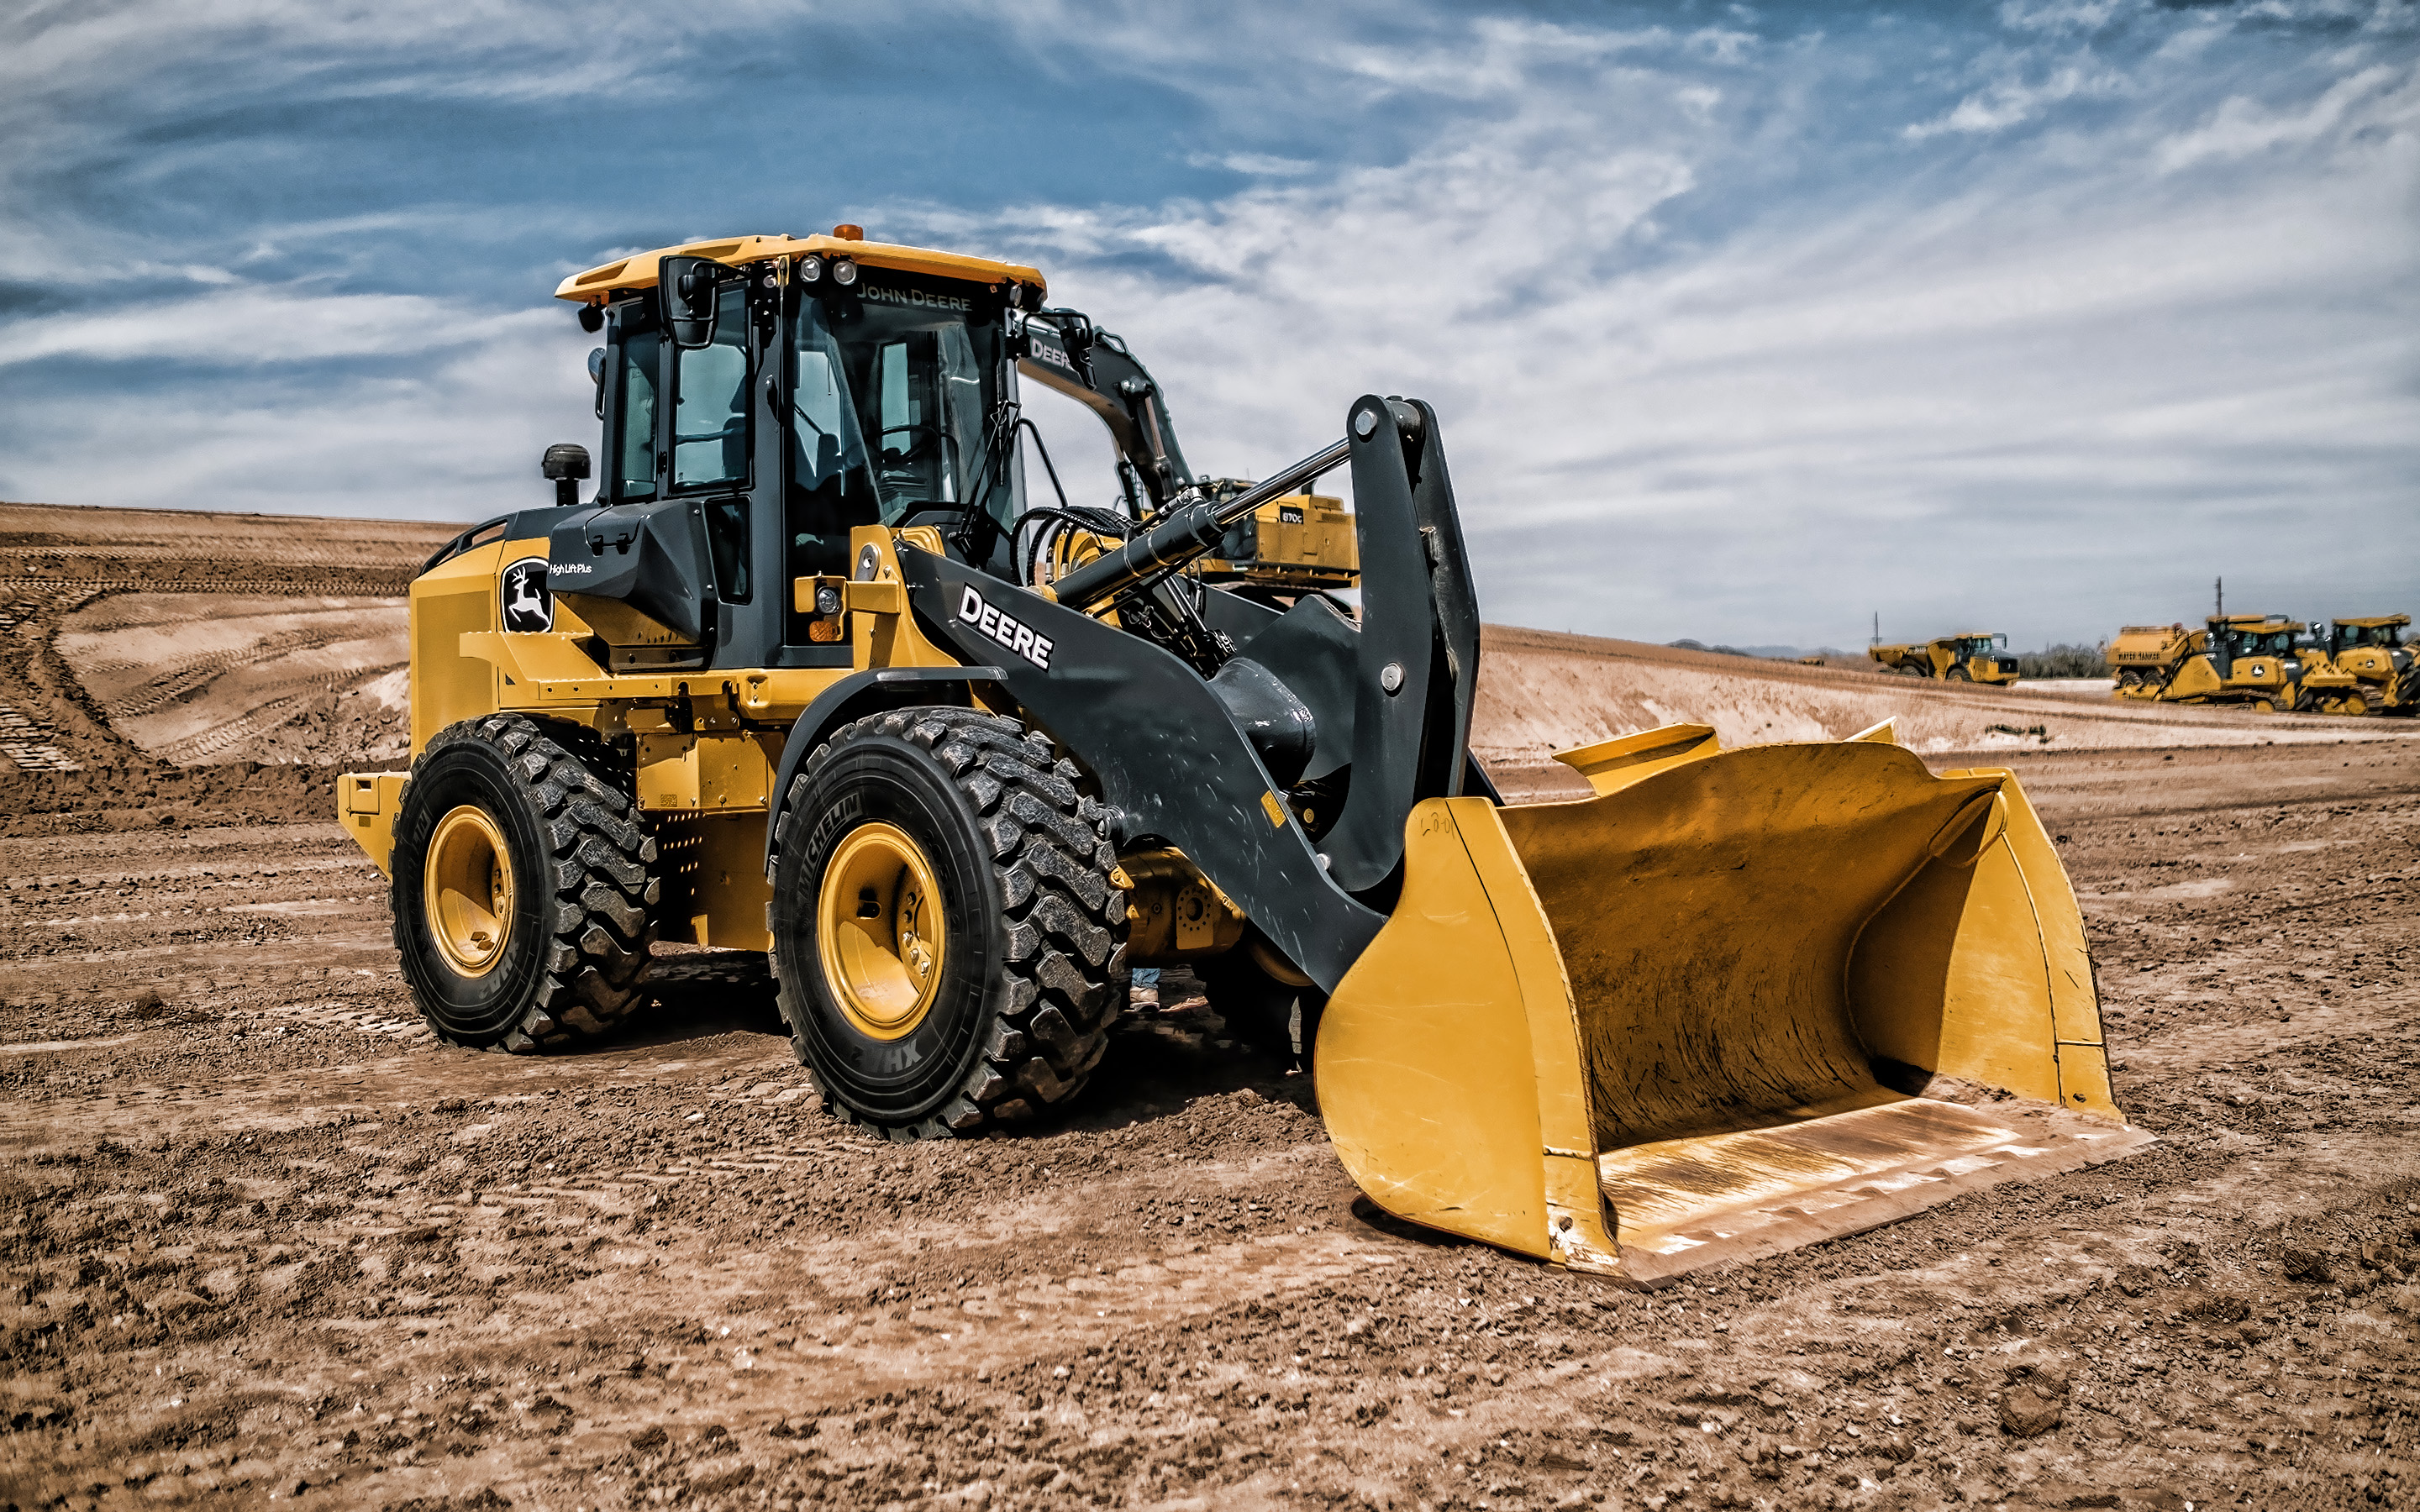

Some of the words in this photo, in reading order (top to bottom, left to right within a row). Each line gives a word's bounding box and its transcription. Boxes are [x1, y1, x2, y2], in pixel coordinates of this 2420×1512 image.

[857, 282, 908, 304] JOHN
[911, 288, 973, 312] DEERE
[1031, 338, 1070, 370] DEER
[549, 563, 565, 577] High
[577, 563, 592, 574] Plus
[958, 585, 1054, 670] DEERE
[797, 792, 860, 901] MICHELIN
